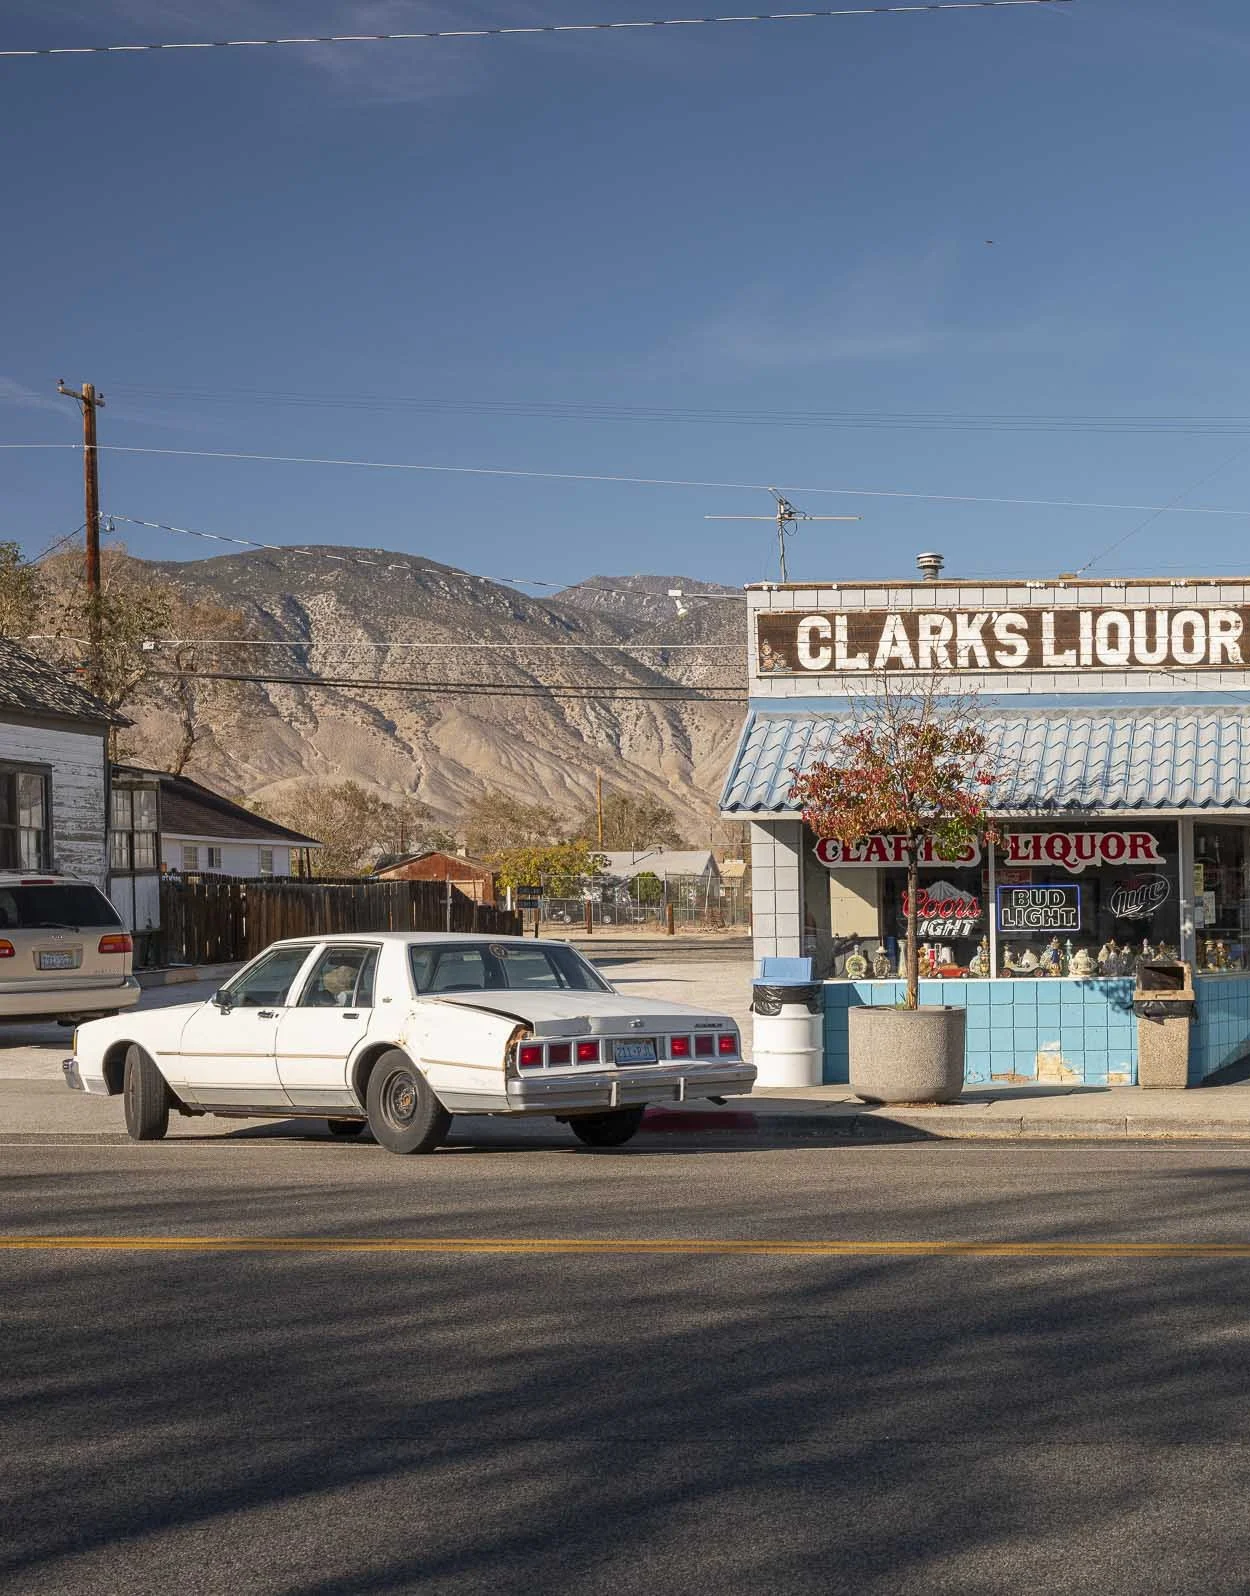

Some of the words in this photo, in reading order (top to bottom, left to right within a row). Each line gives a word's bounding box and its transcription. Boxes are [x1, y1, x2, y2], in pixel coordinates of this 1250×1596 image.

[796, 612, 1030, 670] CLARK'S
[1041, 609, 1245, 667] LIQUOR
[1009, 833, 1156, 868] LIQUOR
[901, 887, 984, 918] Coors
[1012, 889, 1066, 908] BUD
[907, 919, 977, 936] IGHT
